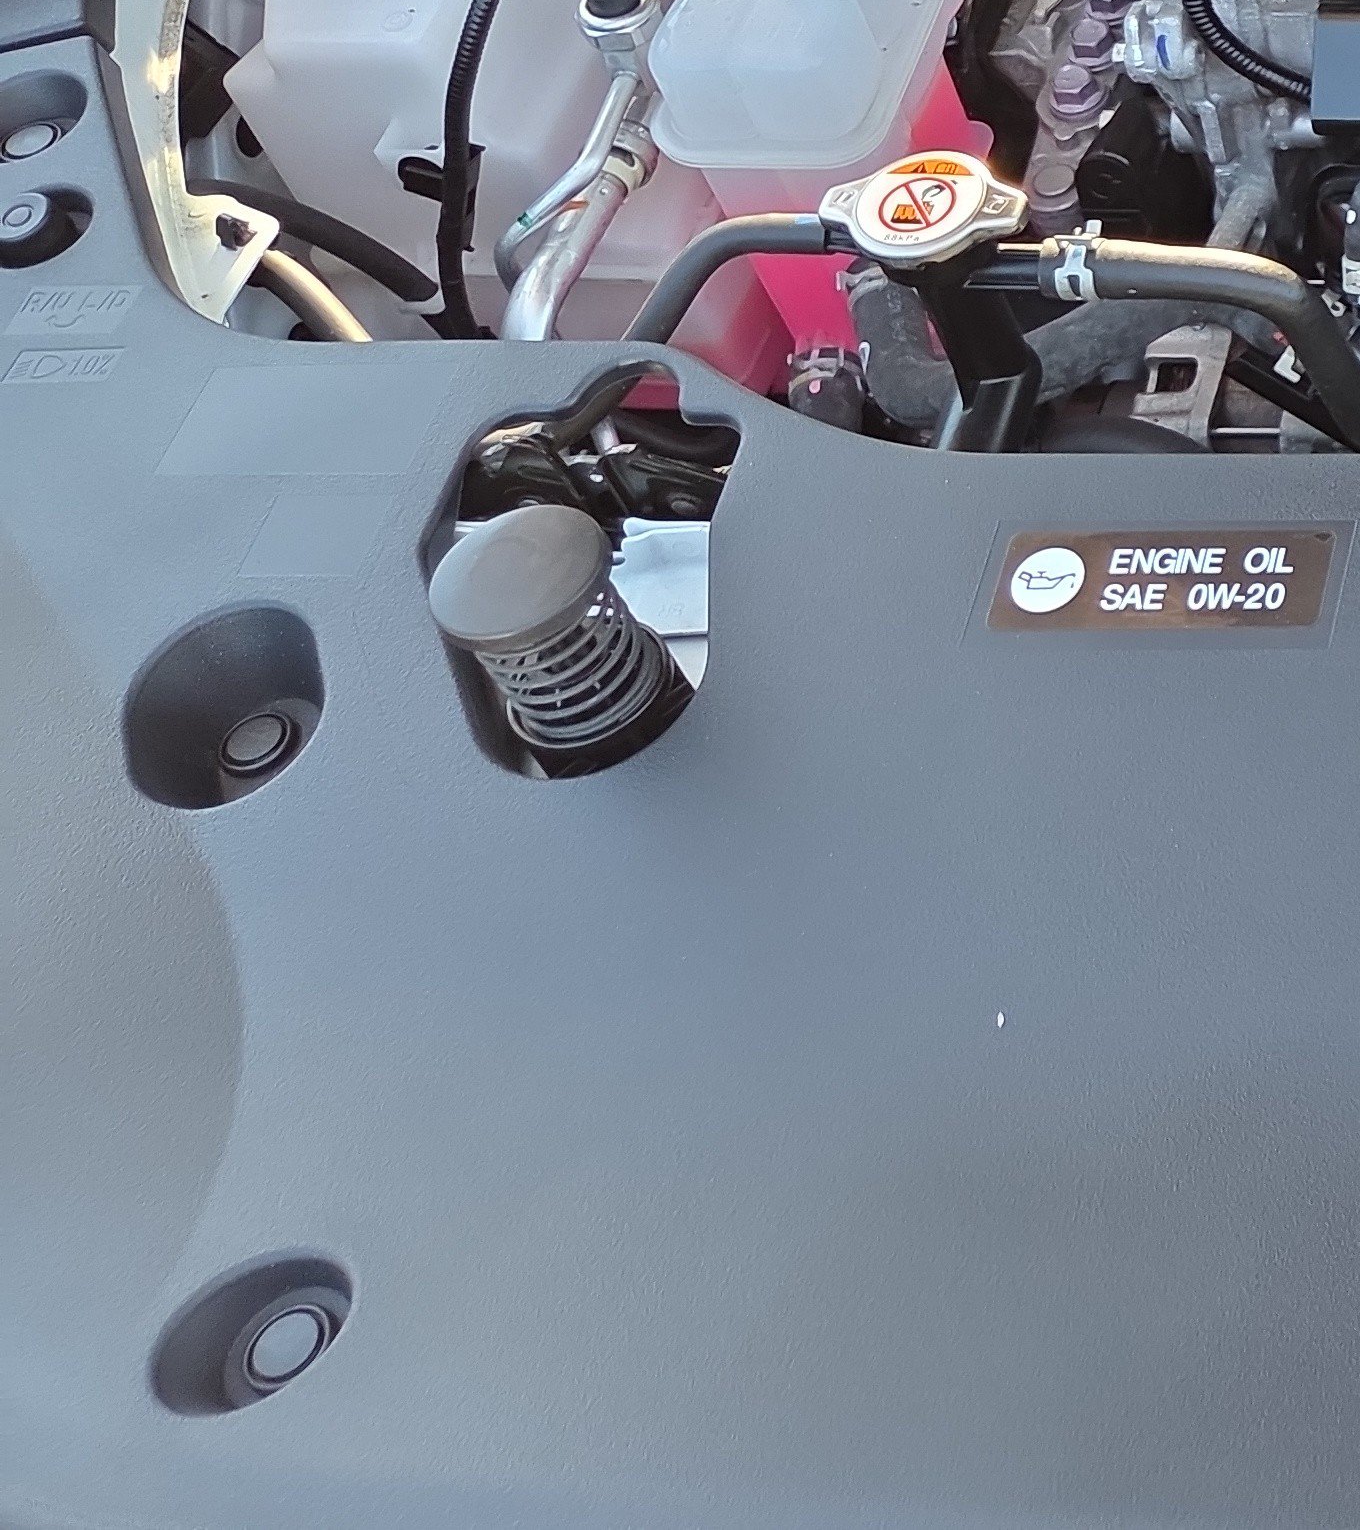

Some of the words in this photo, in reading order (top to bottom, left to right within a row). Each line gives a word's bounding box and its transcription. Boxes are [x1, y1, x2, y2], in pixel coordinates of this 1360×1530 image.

[1108, 547, 1227, 575] ENGINE
[1243, 547, 1294, 574] OIL
[1100, 583, 1168, 611] SAE
[1186, 582, 1286, 611] 0W-20
